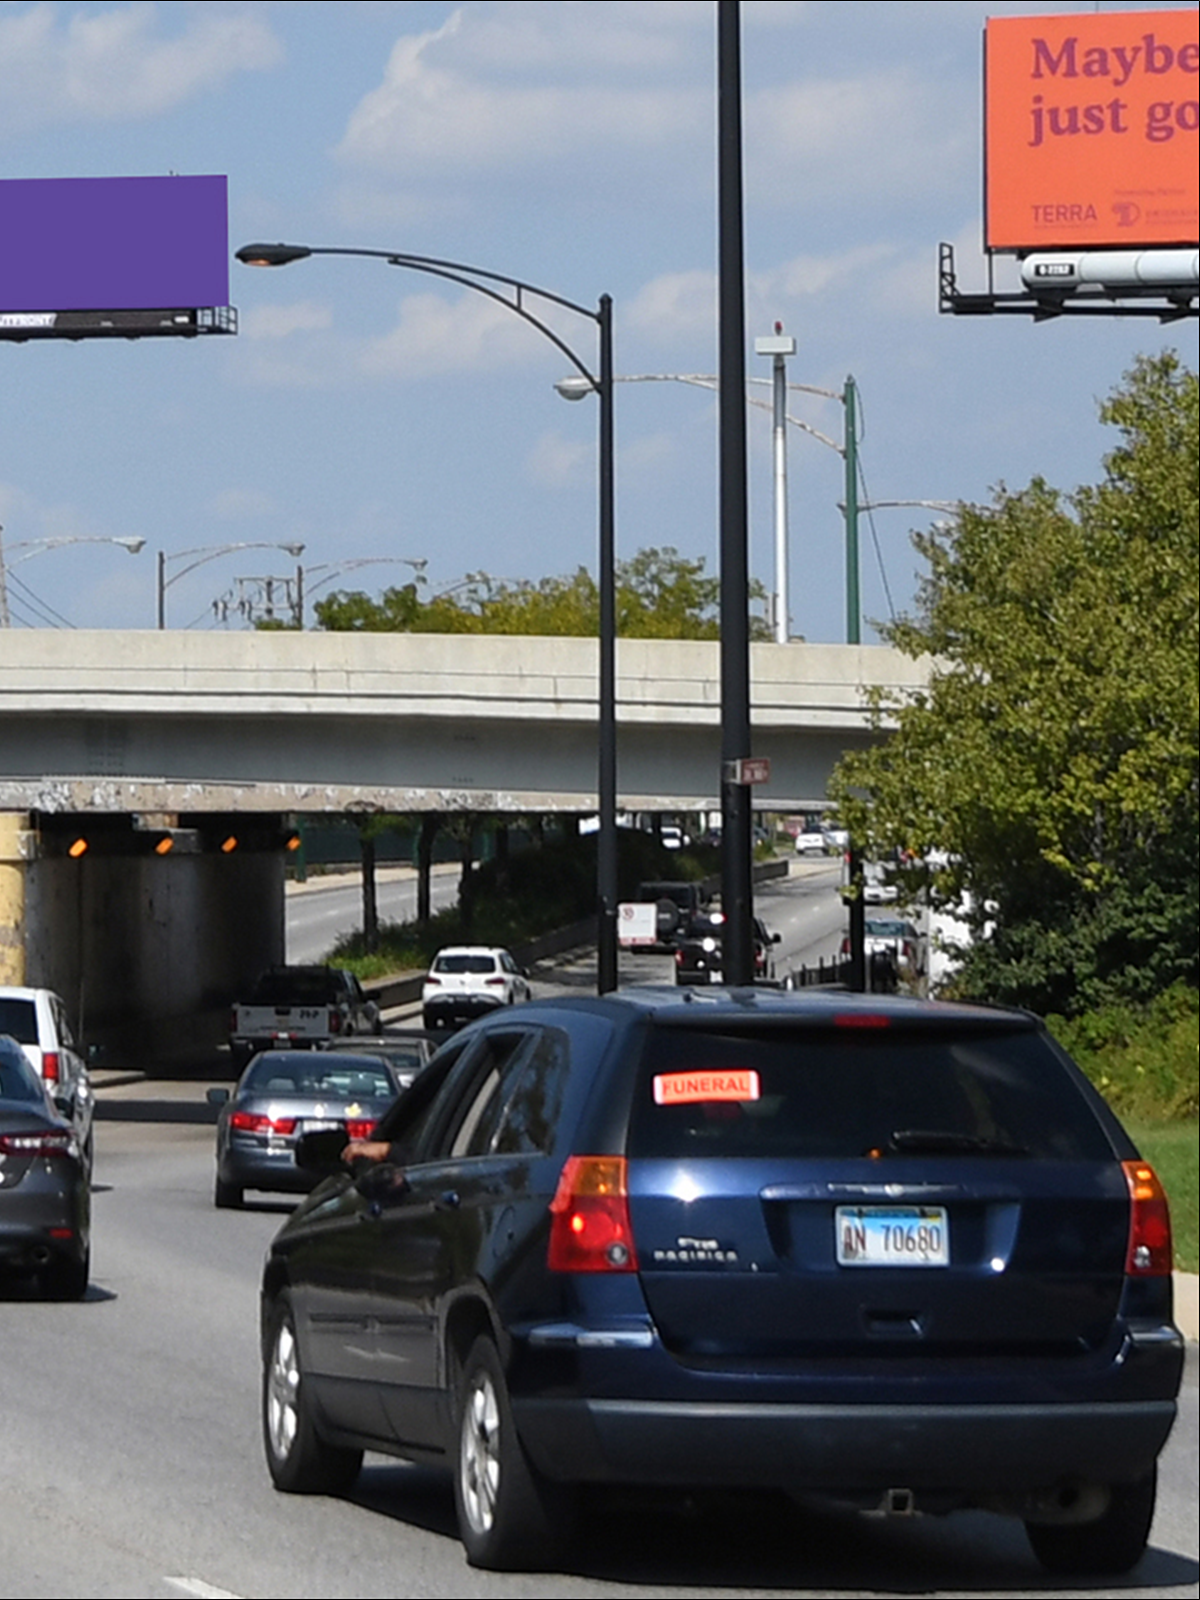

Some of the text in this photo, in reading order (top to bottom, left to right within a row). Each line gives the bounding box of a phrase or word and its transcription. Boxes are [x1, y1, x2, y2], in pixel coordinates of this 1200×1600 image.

[1031, 34, 1199, 86] Maybe
[1028, 95, 1199, 147] just go
[1031, 204, 1097, 223] TERRA
[662, 1078, 749, 1095] FUNERAL
[844, 1225, 940, 1252] AN 70680
